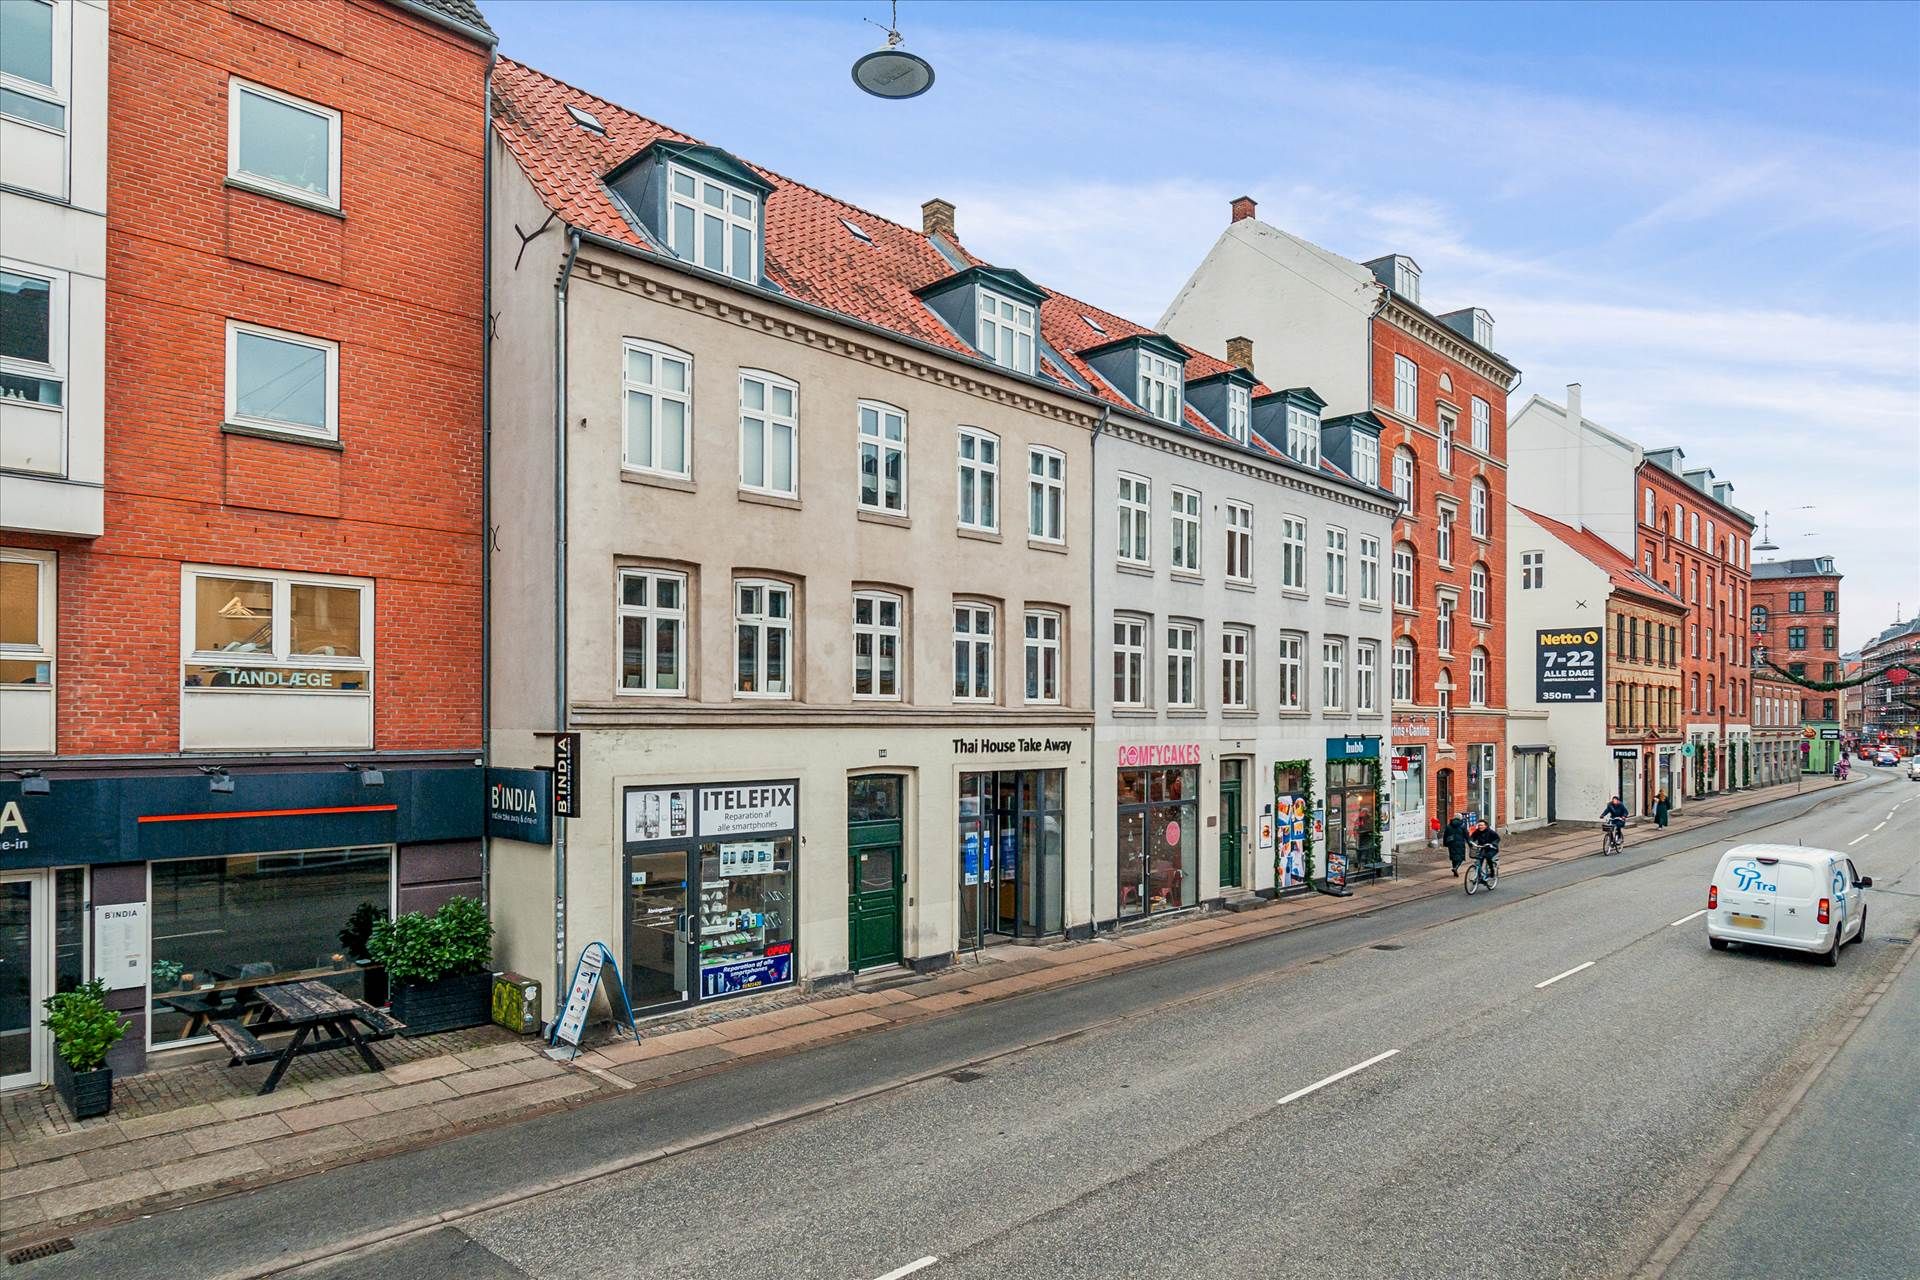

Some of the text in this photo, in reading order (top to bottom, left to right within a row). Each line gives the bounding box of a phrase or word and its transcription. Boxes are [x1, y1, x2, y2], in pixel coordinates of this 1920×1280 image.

[1541, 634, 1582, 645] Netto
[1544, 651, 1594, 667] 7-22
[228, 671, 332, 687] TANDLÆGE
[952, 738, 1072, 754] Thai House Take Away
[1118, 745, 1201, 765] COMFYCAKES
[492, 783, 537, 814] B'INDIA
[703, 787, 792, 811] ITELEFIX
[724, 810, 772, 821] Reparation af
[717, 820, 778, 832] alle smartphones
[767, 944, 791, 956] OPEN
[723, 962, 755, 973] Reparation
[730, 966, 768, 978] smartphones
